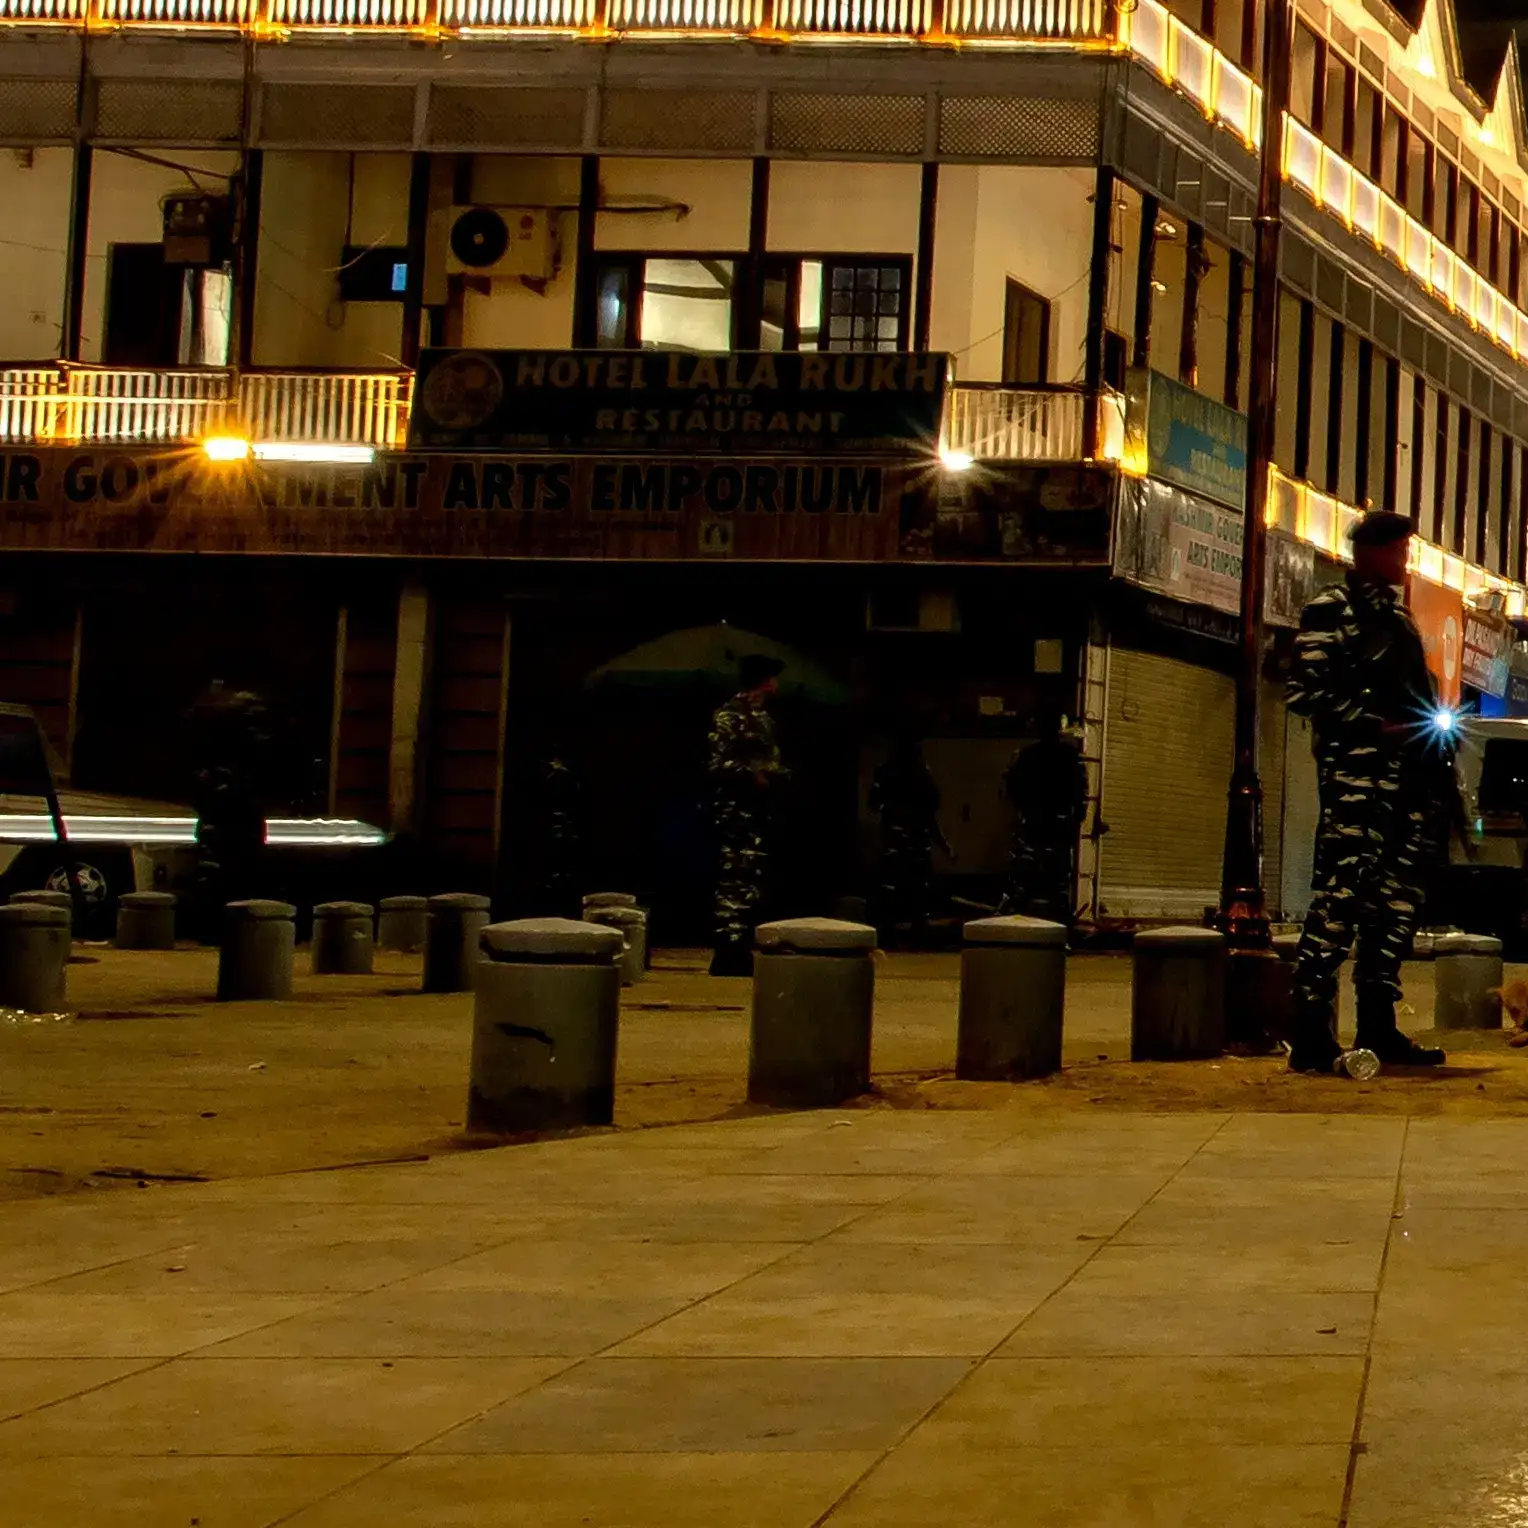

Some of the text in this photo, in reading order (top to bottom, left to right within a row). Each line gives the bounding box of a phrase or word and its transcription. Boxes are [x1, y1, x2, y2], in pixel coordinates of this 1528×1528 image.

[516, 352, 941, 393] HOTEL LALA RUKH
[694, 393, 755, 408] AND
[594, 407, 848, 434] RESTAURANT
[443, 460, 573, 511] ARTS
[590, 463, 886, 515] EMPORIUM
